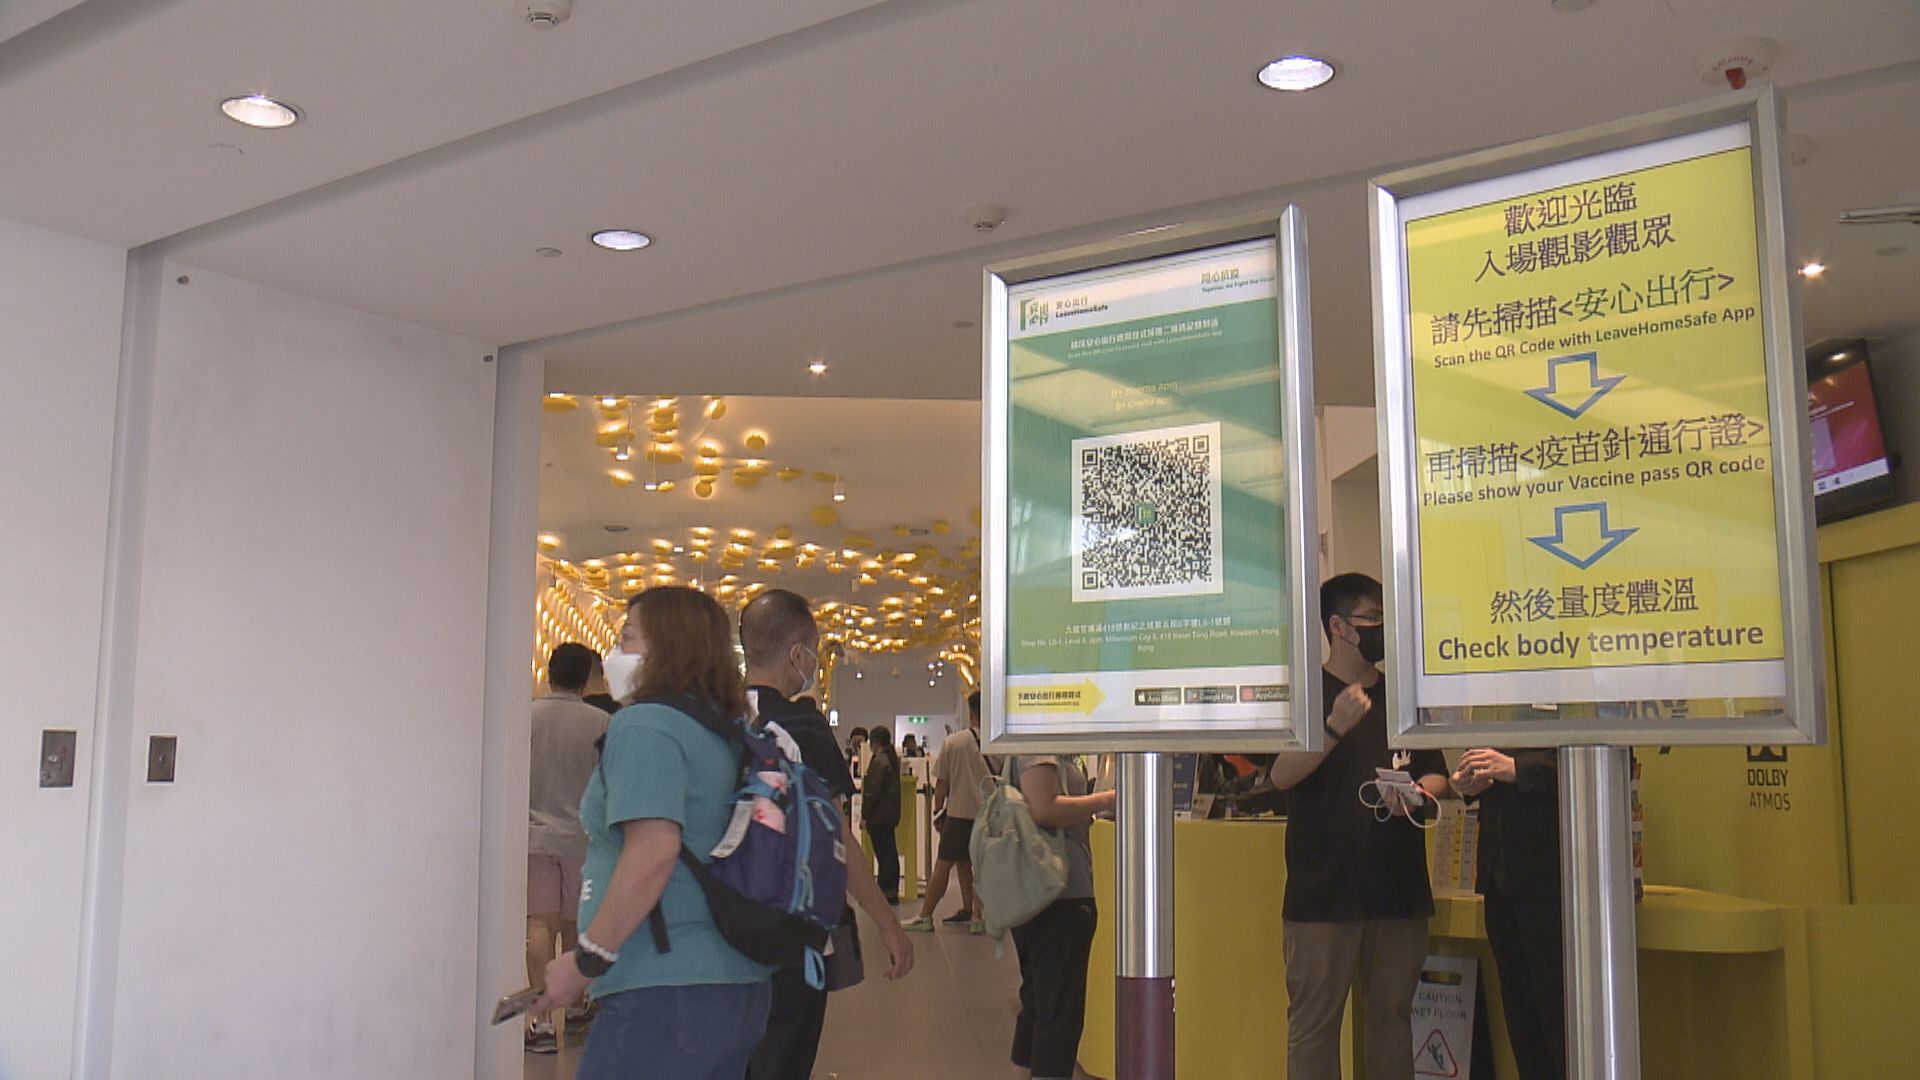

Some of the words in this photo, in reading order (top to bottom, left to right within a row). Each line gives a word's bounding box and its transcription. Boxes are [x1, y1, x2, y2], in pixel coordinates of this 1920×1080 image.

[1504, 182, 1637, 237] 歡迎光臨
[1474, 214, 1675, 282] 入場觀影觀眾
[1431, 267, 1735, 345] 請先掃描<安心出行>
[1434, 354, 1465, 368] Scan
[1469, 349, 1491, 362] the
[1495, 343, 1516, 359] QR
[1520, 337, 1555, 355] Code
[1559, 331, 1591, 348] with
[1596, 312, 1718, 343] LeaveHomeSafe
[1722, 306, 1755, 326] App
[1426, 413, 1765, 482] 再掃描<疫苗針通行證>
[1423, 490, 1473, 506] Please
[1478, 484, 1521, 501] show
[1526, 480, 1564, 499] your
[1568, 472, 1635, 490] Vaccine
[1641, 467, 1680, 485] pass
[1685, 461, 1713, 479] QR
[1719, 455, 1765, 473] code
[1490, 577, 1699, 624] 然後量度體溫
[1438, 634, 1510, 661] Check
[1517, 631, 1580, 658] body
[1587, 623, 1764, 656] temperature
[1747, 768, 1788, 786] DOLBY
[1750, 793, 1792, 811] ATMOS
[1419, 992, 1461, 1004] CAUTION
